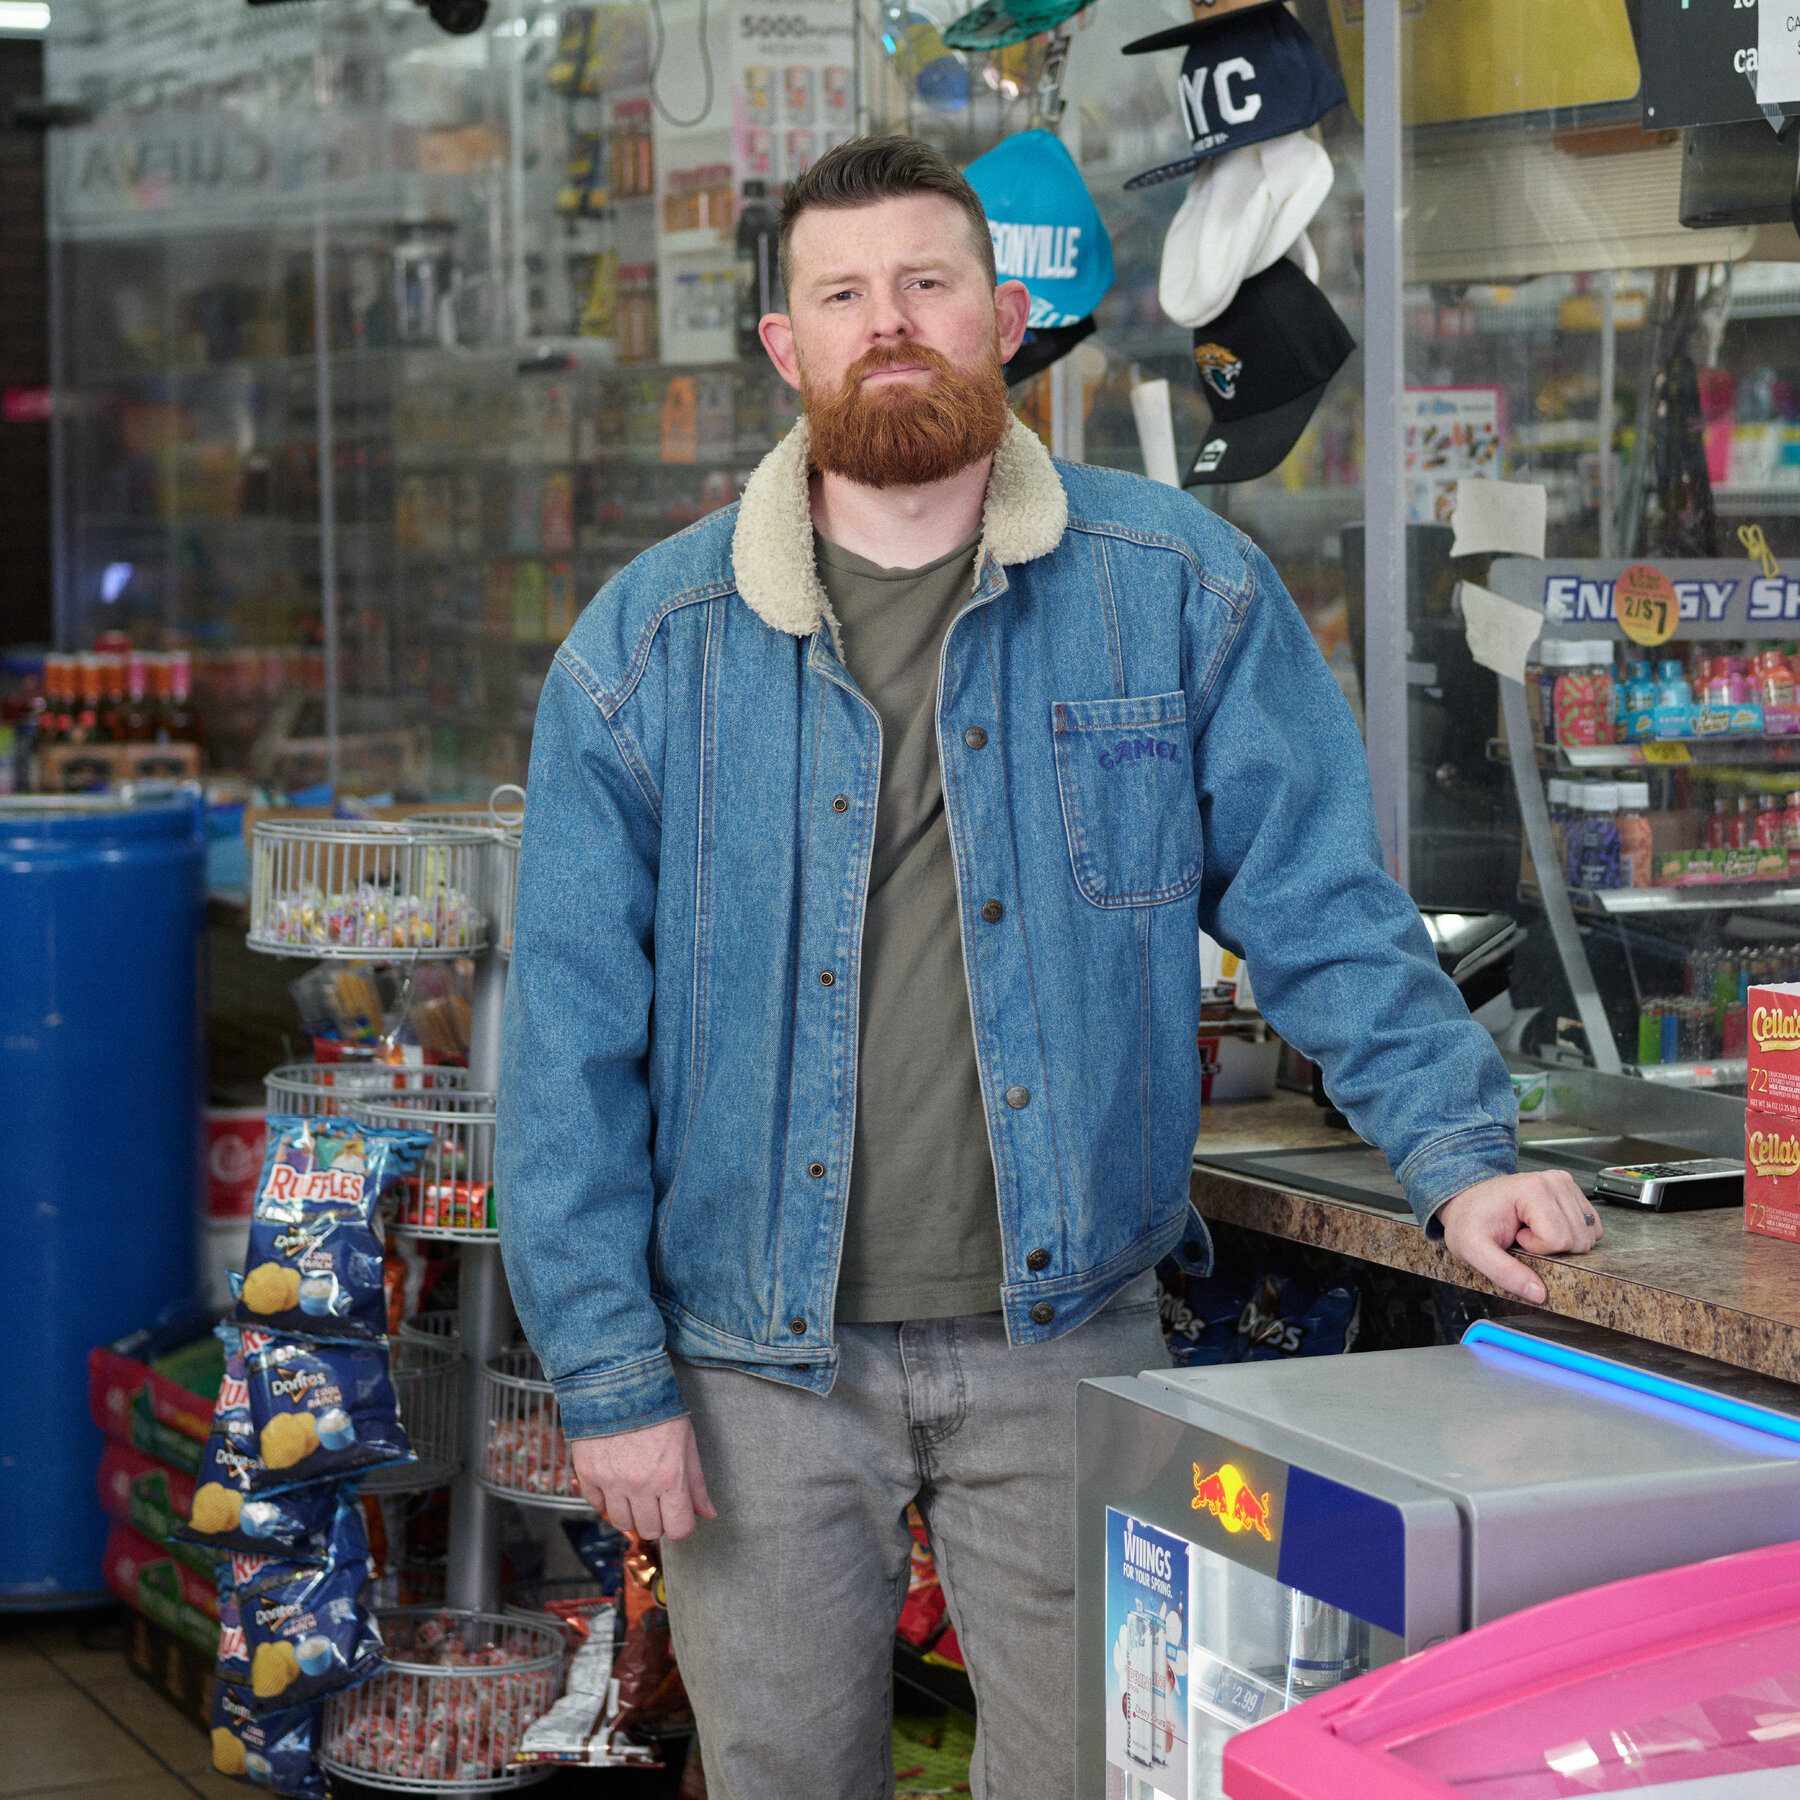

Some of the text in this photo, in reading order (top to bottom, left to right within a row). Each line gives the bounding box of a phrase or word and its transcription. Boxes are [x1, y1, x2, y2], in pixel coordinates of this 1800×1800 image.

[1098, 737, 1182, 770] CAMEL
[1751, 1067, 1768, 1093] 72
[1749, 1131, 1800, 1167] Cella's
[265, 1167, 361, 1202] RUFFLES
[1749, 1203, 1765, 1229] 72
[271, 1369, 327, 1396] Doritos
[307, 1395, 343, 1409] RANCH
[1123, 1530, 1172, 1581] WIIINGS
[1123, 1562, 1135, 1580] FOR
[1135, 1567, 1151, 1588] YOUR
